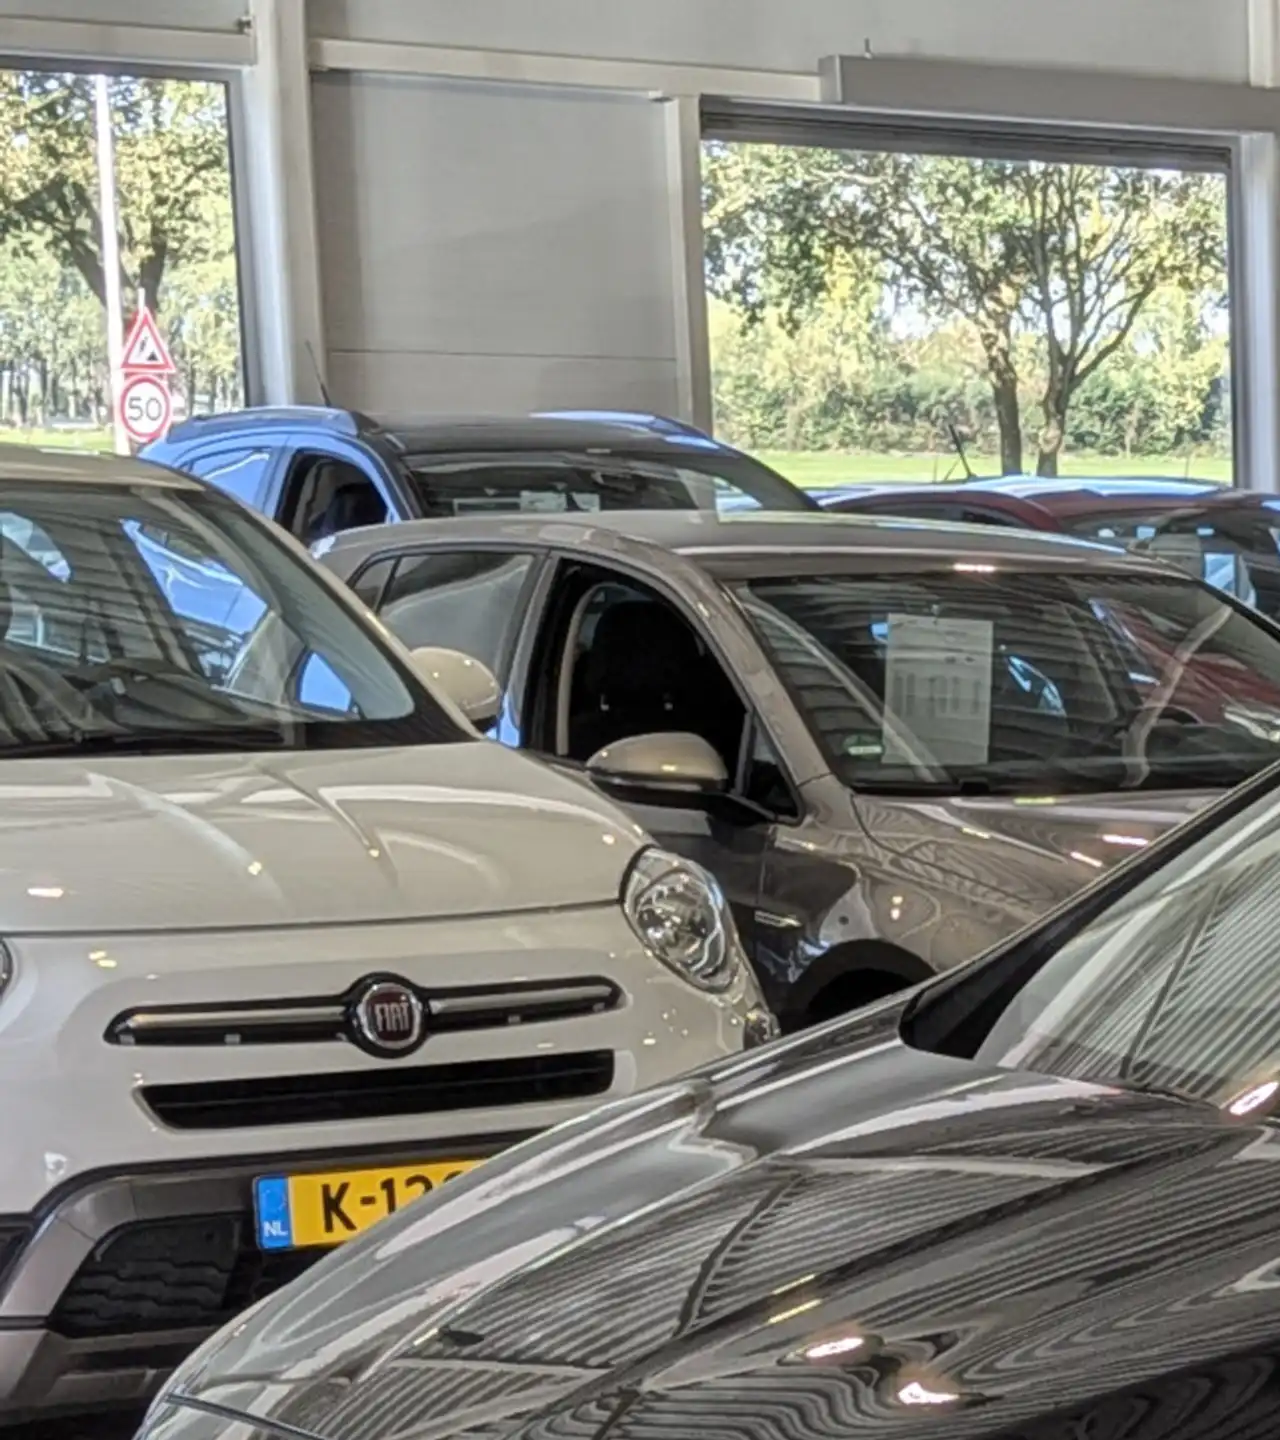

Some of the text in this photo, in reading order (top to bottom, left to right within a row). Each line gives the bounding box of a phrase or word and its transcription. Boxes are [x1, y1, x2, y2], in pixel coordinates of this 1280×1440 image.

[128, 396, 162, 421] 50
[320, 1170, 464, 1233] K-1
[263, 1220, 289, 1237] NL
